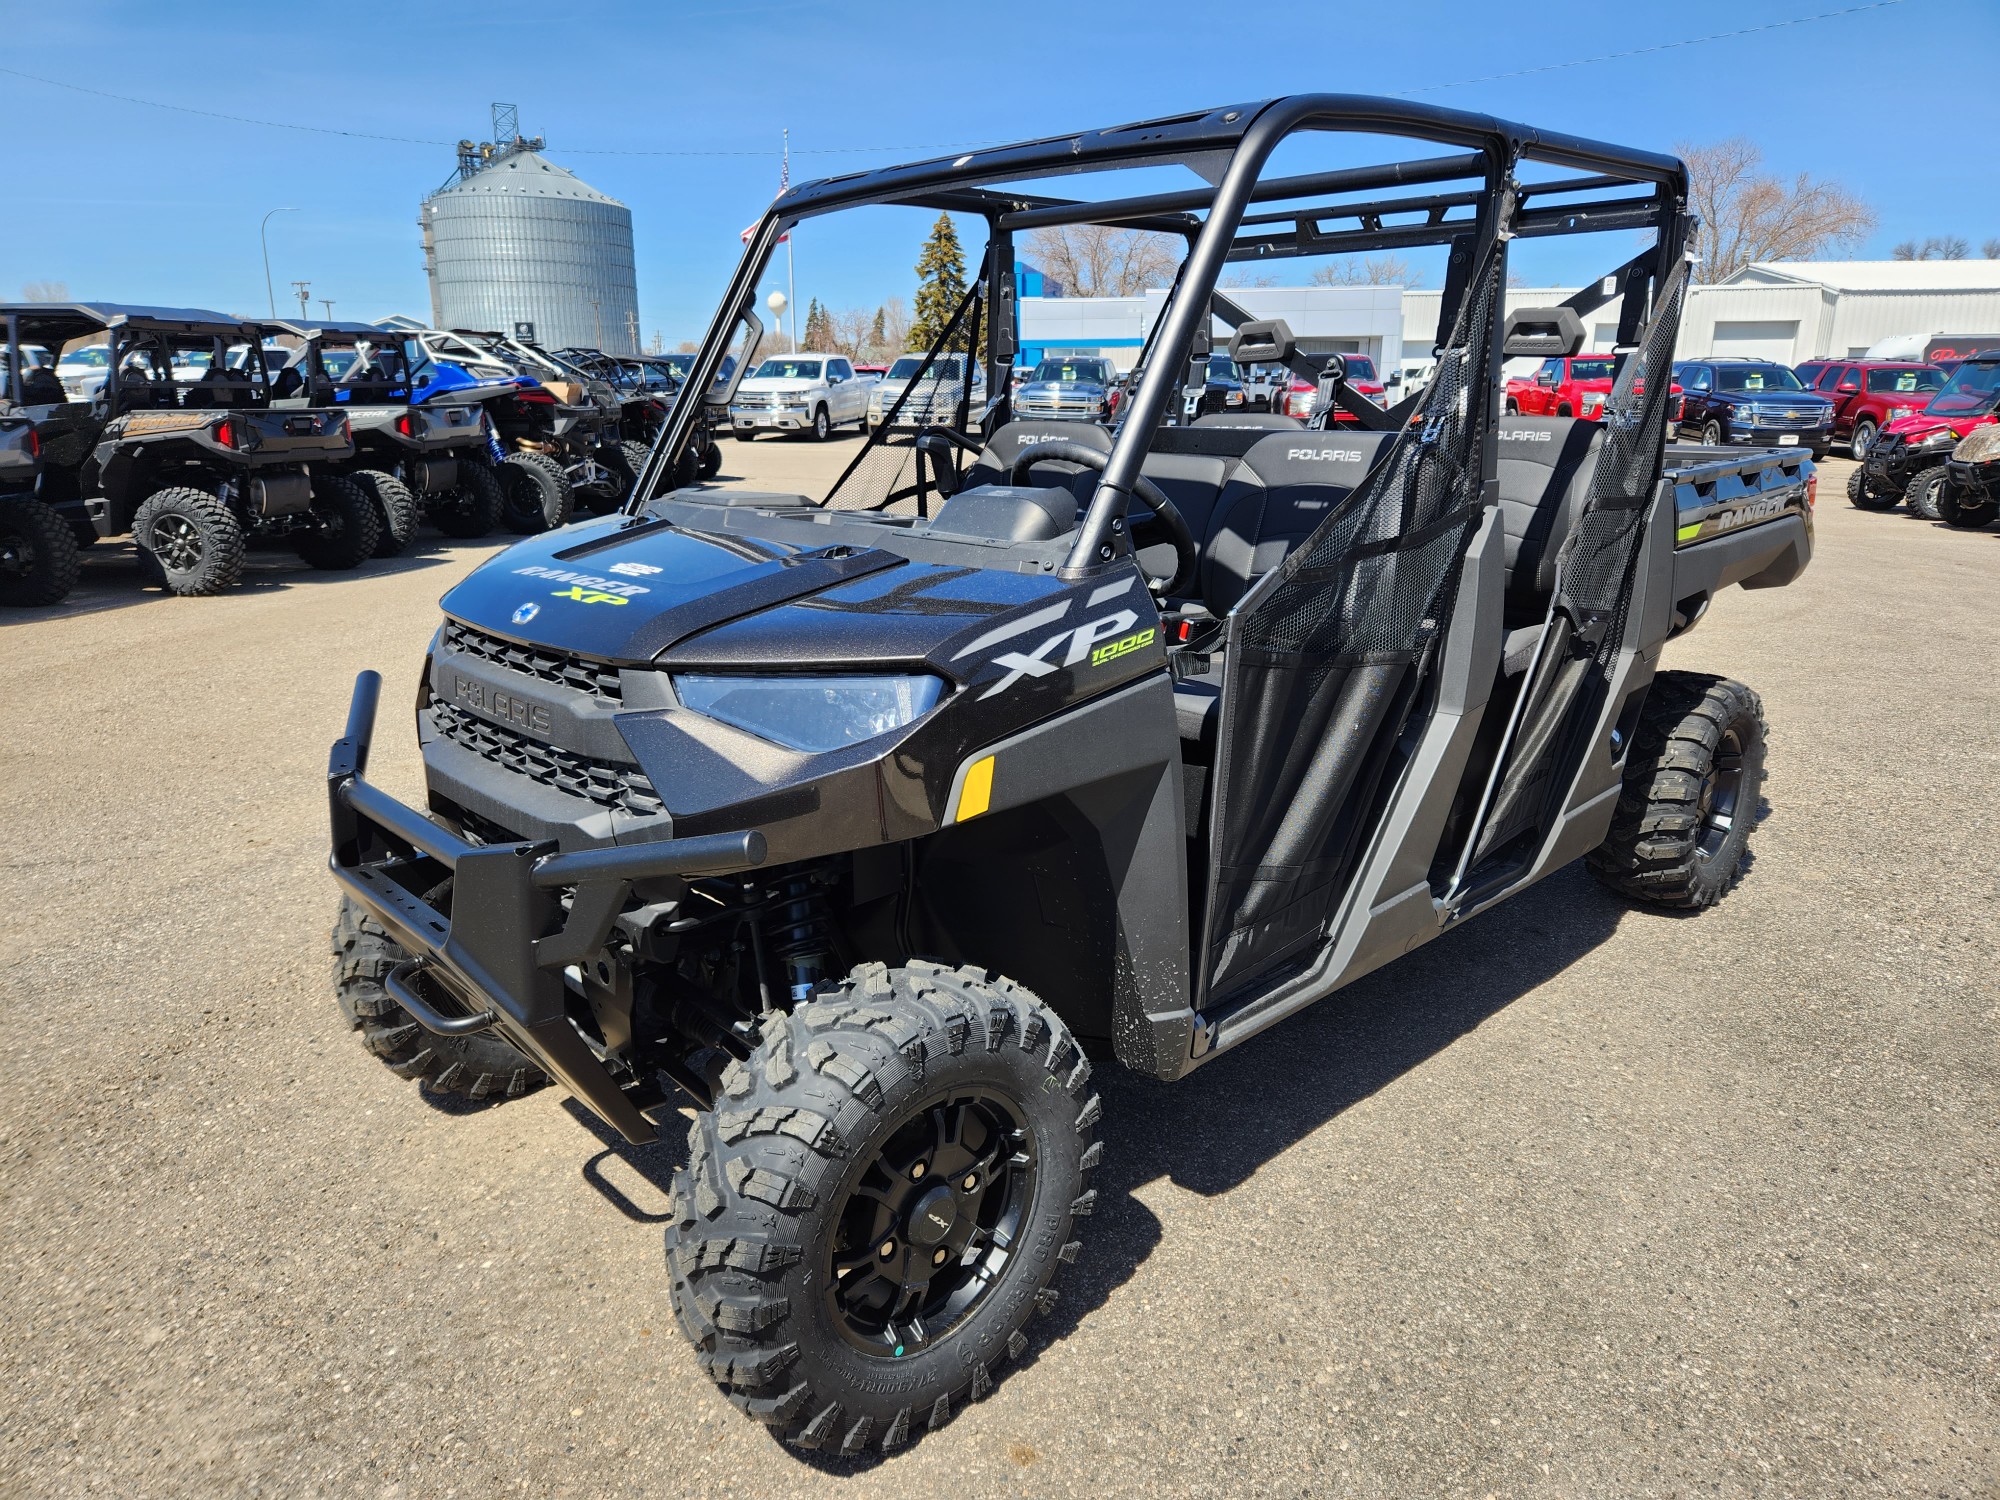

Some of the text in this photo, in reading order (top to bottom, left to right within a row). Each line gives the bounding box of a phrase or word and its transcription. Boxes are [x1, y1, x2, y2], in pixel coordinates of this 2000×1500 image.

[1287, 448, 1362, 462] POLARIS
[1718, 496, 1786, 530] RANGER
[511, 566, 651, 596] RANGER
[551, 586, 629, 606] XP
[976, 609, 1139, 701] XP
[1092, 628, 1155, 662] 1000
[454, 675, 551, 736] POLARIS
[1031, 1214, 1061, 1263] PRO
